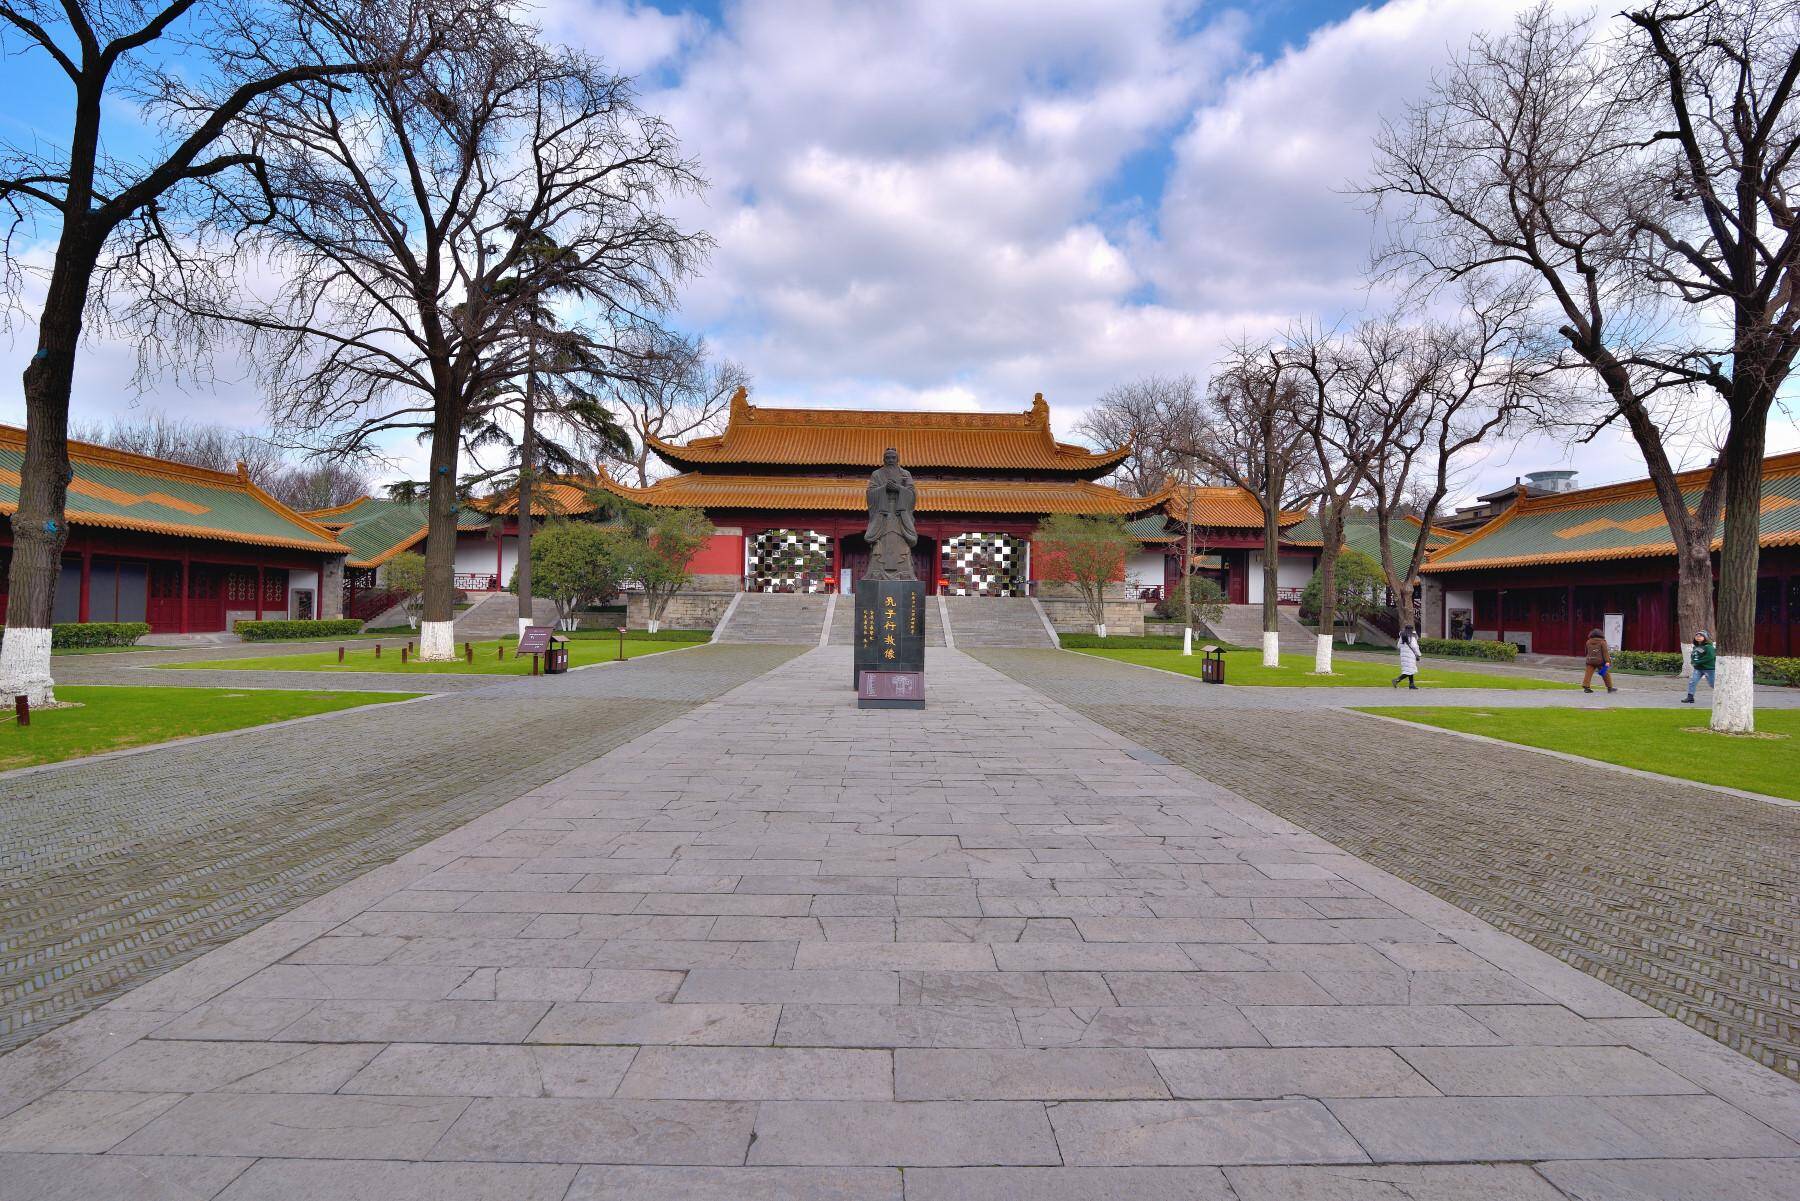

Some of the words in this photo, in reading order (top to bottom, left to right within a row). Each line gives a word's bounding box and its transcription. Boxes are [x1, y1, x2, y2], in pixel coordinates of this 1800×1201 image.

[884, 596, 897, 660] 孔子行教像
